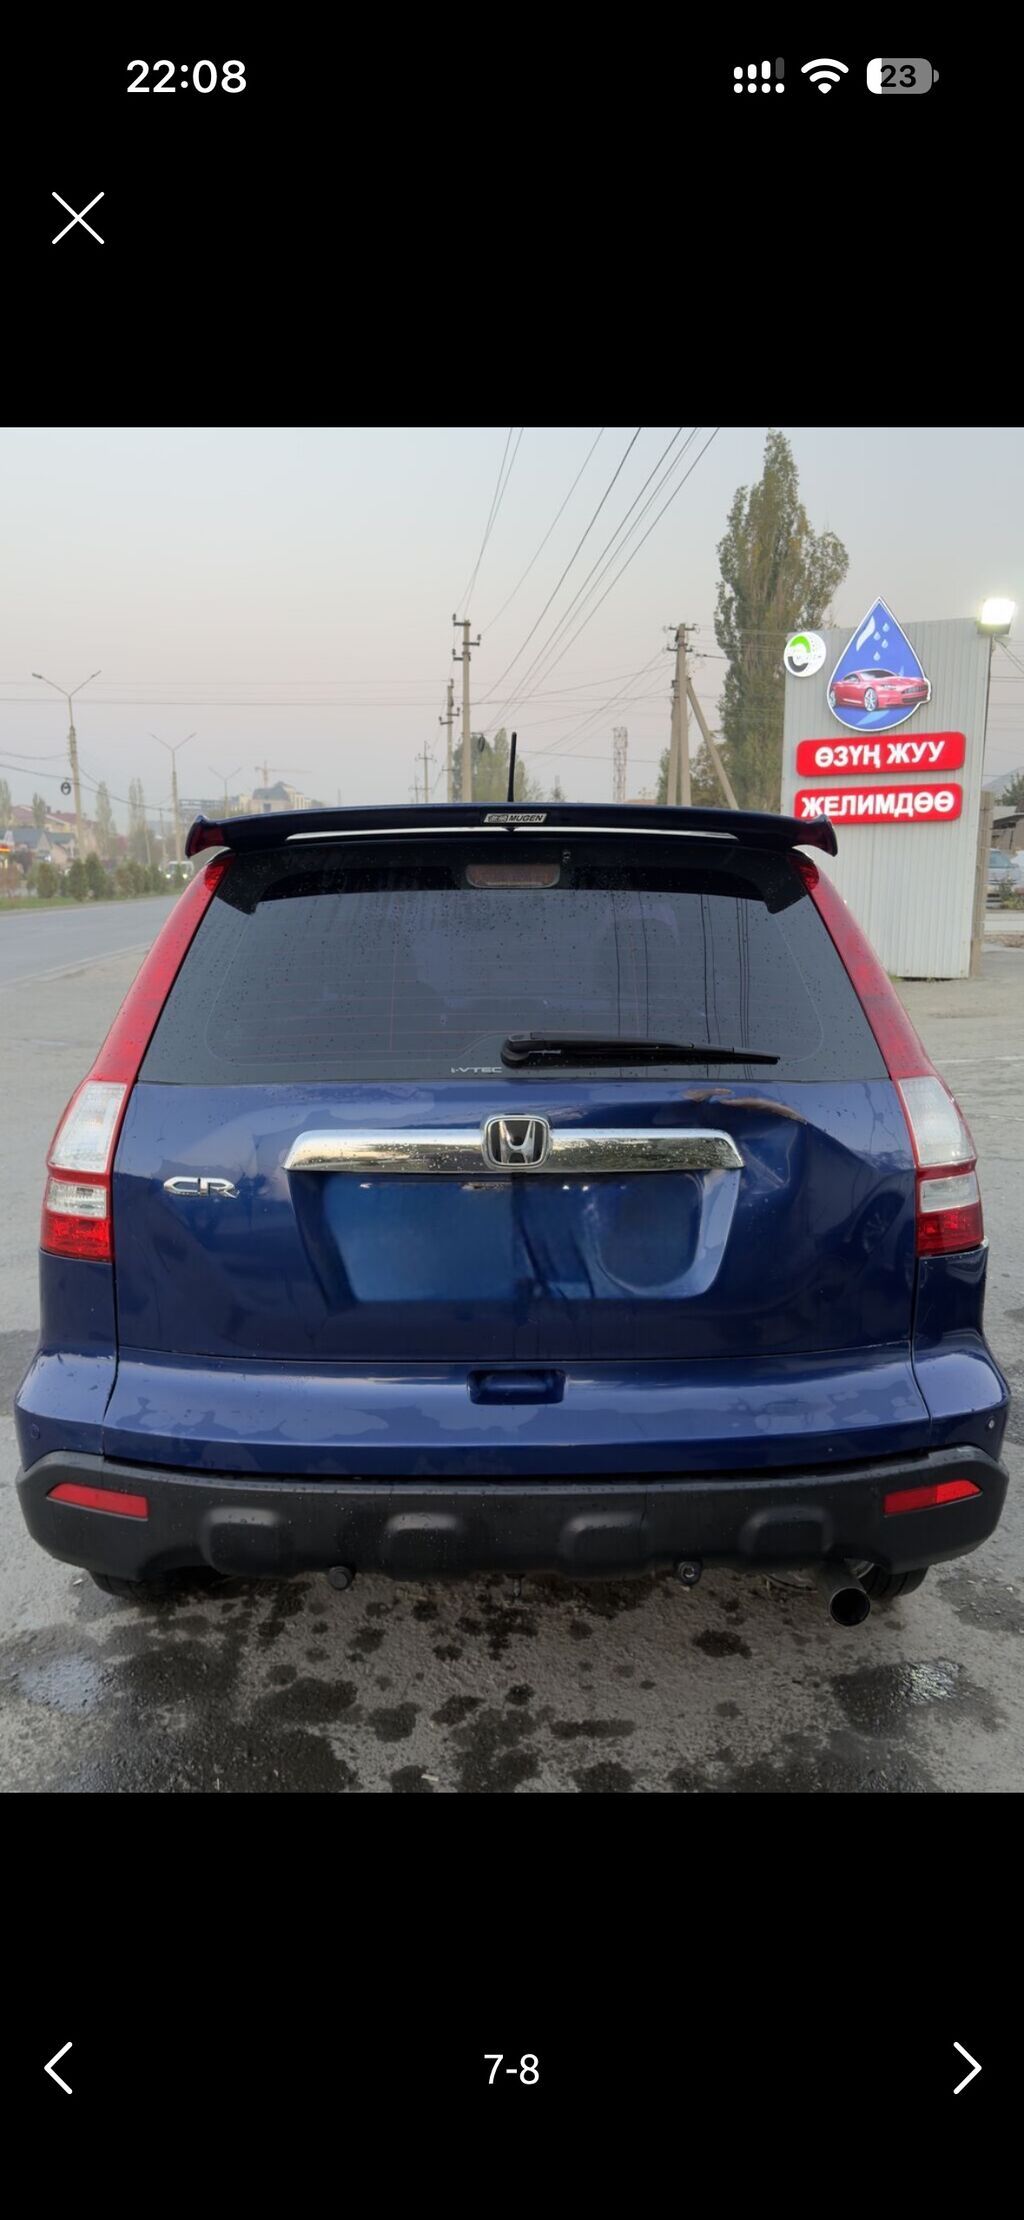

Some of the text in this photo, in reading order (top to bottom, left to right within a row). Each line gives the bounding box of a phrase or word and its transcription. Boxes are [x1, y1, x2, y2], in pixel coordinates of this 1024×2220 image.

[815, 741, 945, 768] ӨЗҮҢ ЖУУ
[508, 814, 544, 822] MUGEN
[801, 791, 955, 818] ЖЕЛИМДӨӨ
